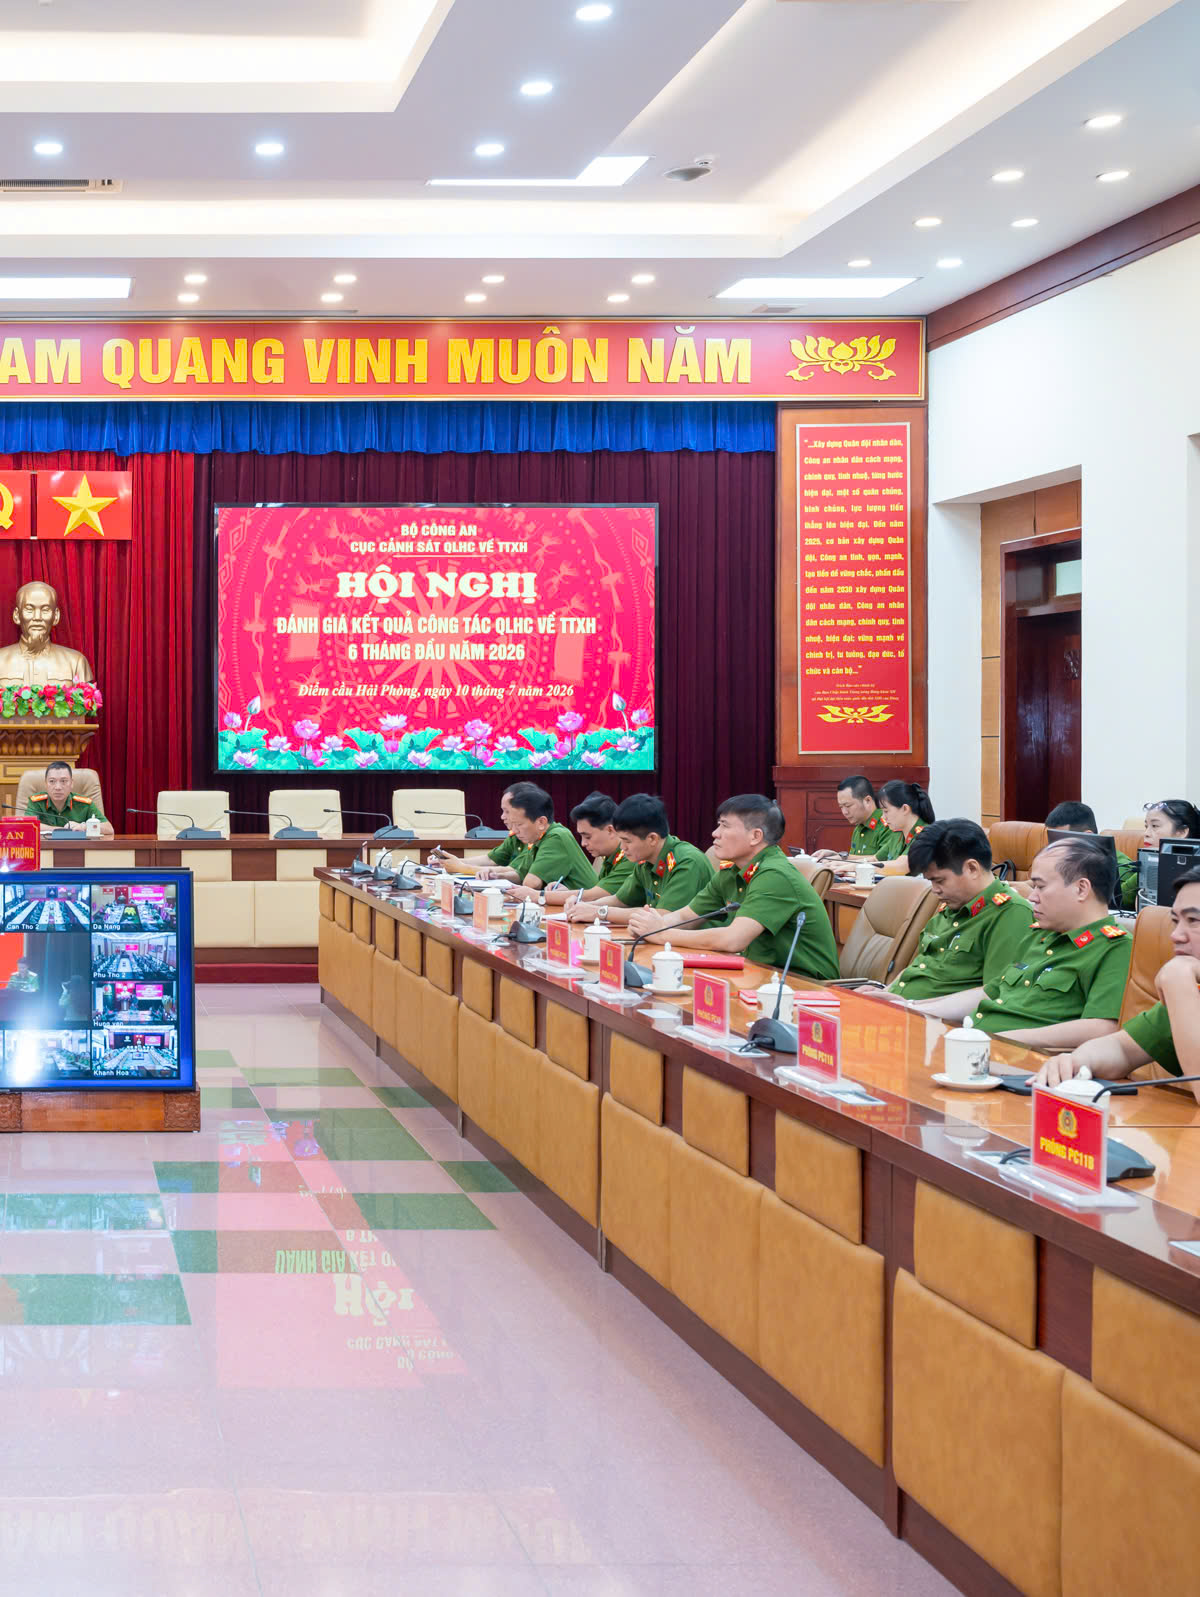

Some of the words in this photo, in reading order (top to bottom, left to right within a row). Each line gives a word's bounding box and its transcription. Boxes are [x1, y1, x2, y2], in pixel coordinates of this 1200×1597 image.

[102, 336, 285, 389] QUANG
[304, 337, 427, 384] VINH
[447, 326, 609, 384] MUÔN
[627, 321, 752, 384] NĂM
[401, 524, 417, 539] BỘ
[422, 524, 455, 536] CÔNG
[459, 525, 477, 536] AN
[351, 542, 375, 555] CỤC
[379, 538, 413, 553] CẢNH
[417, 539, 440, 553] SÁT
[443, 542, 476, 554] QLHC
[479, 538, 494, 553] VỀ
[498, 542, 527, 553] TTXH
[336, 564, 415, 603] HỘI
[426, 572, 537, 603] NGHỊ
[277, 613, 318, 634] ĐÁNH
[322, 613, 348, 634] GIÁ
[352, 612, 380, 634] KẾT
[384, 611, 414, 635] QUẢ
[417, 614, 458, 634] CÔNG
[464, 613, 491, 634] TÁC
[495, 617, 533, 635] QLHC
[538, 611, 556, 634] VỀ
[560, 617, 596, 634] TTXH
[349, 644, 357, 660] 6
[362, 640, 410, 660] THÁNG
[415, 637, 445, 660] ĐẦU
[450, 641, 484, 660] NĂM
[489, 644, 525, 660] 2026
[298, 682, 328, 696] Điểm
[332, 682, 352, 696] cầu
[356, 684, 377, 696] Hải
[381, 684, 420, 698] Phòng,
[424, 684, 452, 699] ngày
[456, 685, 469, 696] 10
[472, 685, 504, 698] tháng
[509, 685, 515, 696] 7
[518, 686, 543, 696] năm
[546, 685, 574, 696] 2026
[6, 832, 24, 840] AN
